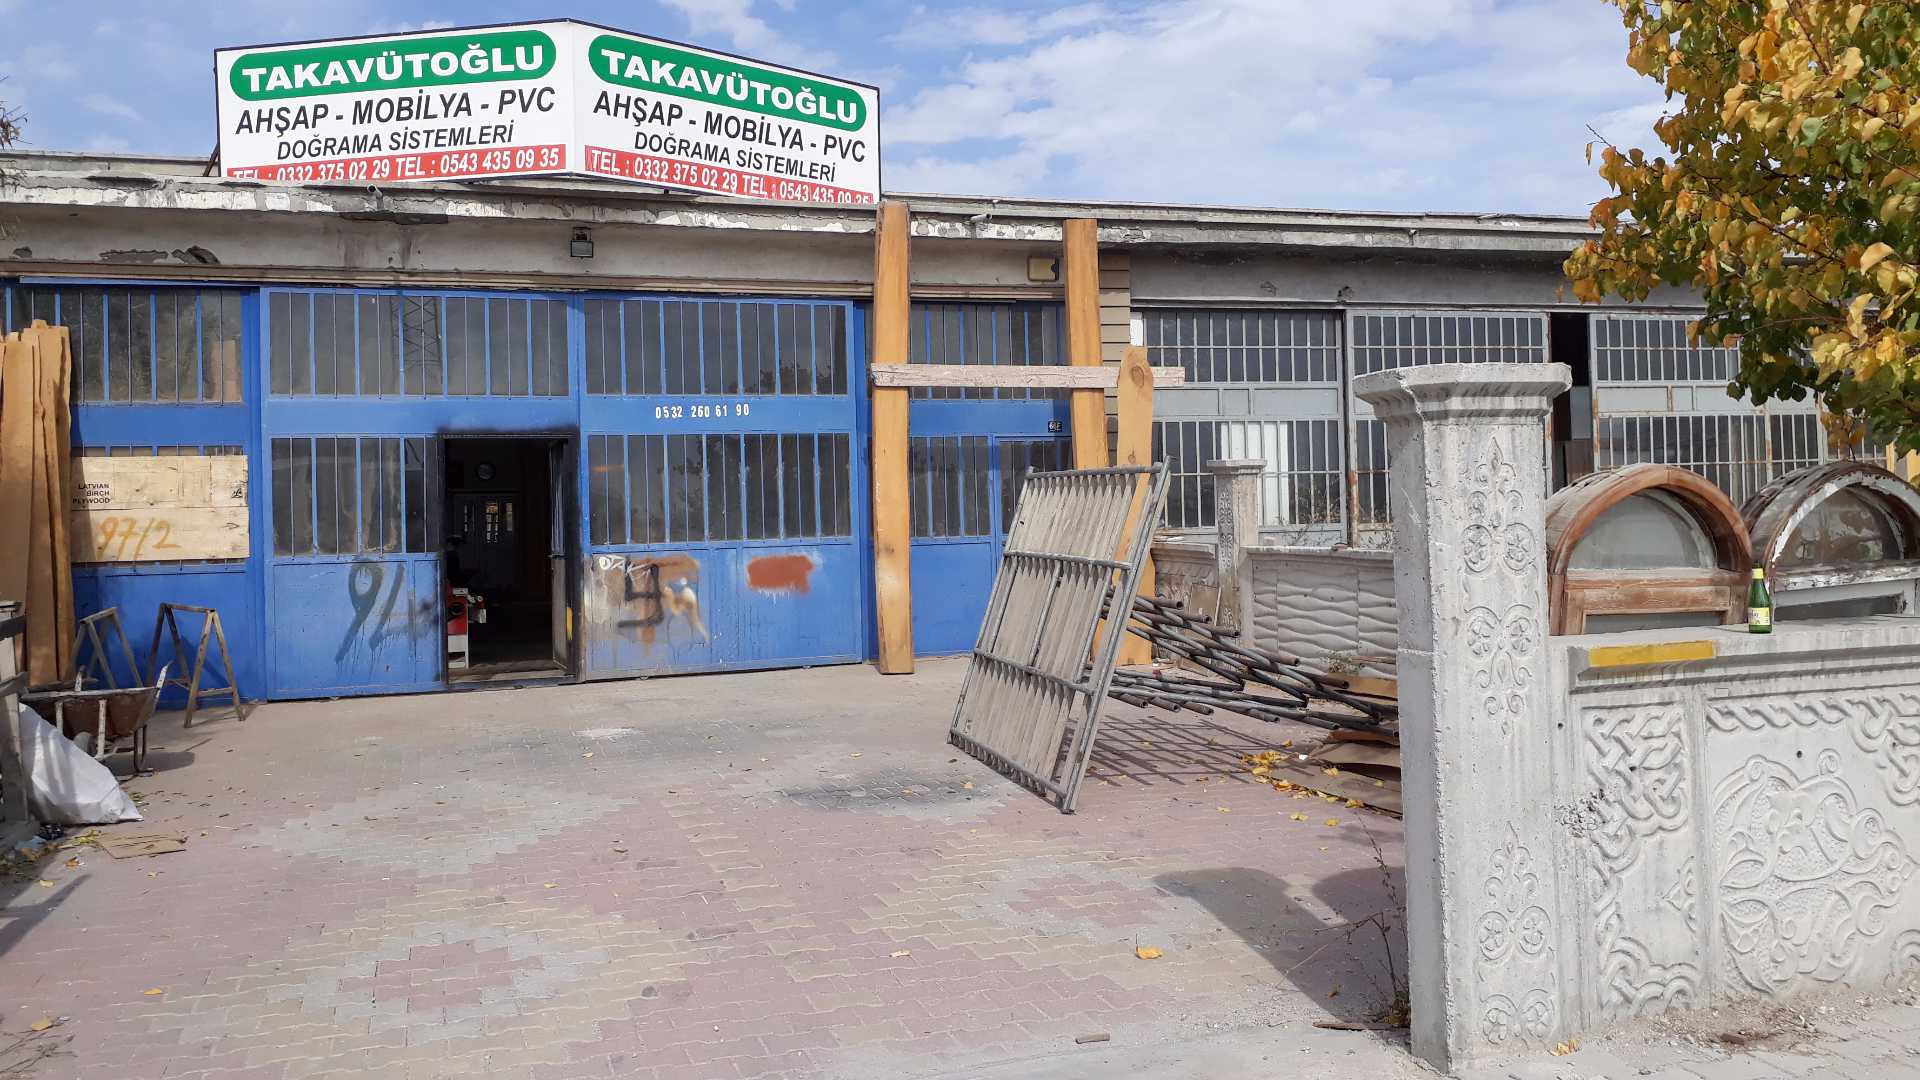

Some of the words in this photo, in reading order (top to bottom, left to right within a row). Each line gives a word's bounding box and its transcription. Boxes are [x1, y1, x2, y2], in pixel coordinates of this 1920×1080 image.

[242, 44, 543, 93] TAKAVÜTOĞLU
[600, 48, 857, 124] TAKAVÜTOĞLU
[235, 103, 329, 137] AHŞAP
[352, 89, 472, 125] MOBİLYA
[498, 86, 556, 115] PVC
[593, 90, 683, 127] AHŞAP
[703, 110, 804, 151] MOBİLYA
[823, 134, 866, 162] PVC
[276, 165, 313, 180] 0332
[317, 162, 345, 180] 375
[349, 160, 368, 180] 02
[372, 159, 390, 179] 29
[395, 156, 426, 176] TEL
[440, 152, 478, 174] 0543
[482, 150, 511, 171] 435
[515, 148, 535, 169] 09
[539, 147, 560, 168] 35
[277, 133, 382, 160] DOĞRAMA
[388, 119, 514, 150] SİSTEMLERİ
[634, 131, 731, 166] DOĞRAMA
[736, 146, 837, 183] SİSTEMLERİ
[591, 149, 620, 172] TEL
[634, 157, 669, 180] 0332
[673, 162, 698, 183] 375
[701, 167, 718, 187] 02
[722, 170, 738, 191] 29
[742, 174, 767, 195] TEL
[780, 181, 809, 200] 0543
[812, 186, 834, 203] 435
[655, 405, 683, 419] 0532
[691, 405, 710, 418] 260
[715, 404, 728, 417] 61
[735, 403, 750, 416] 90
